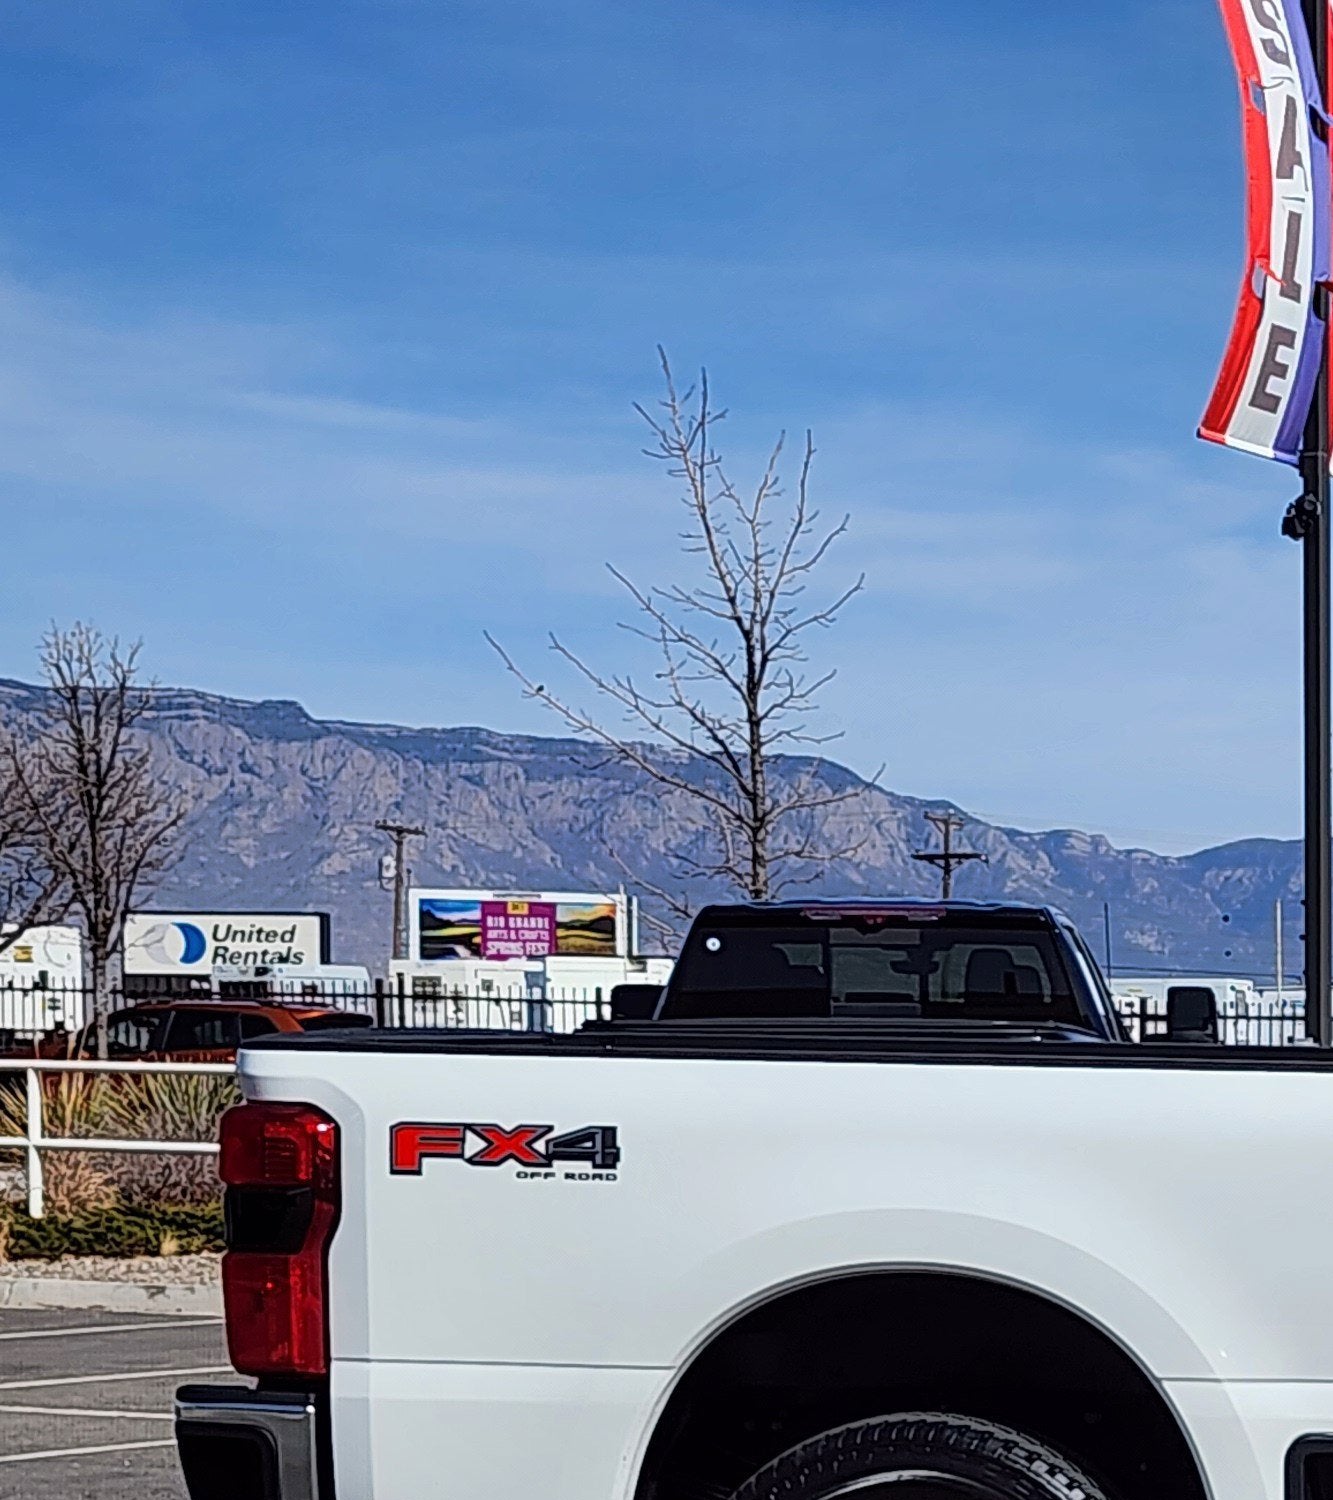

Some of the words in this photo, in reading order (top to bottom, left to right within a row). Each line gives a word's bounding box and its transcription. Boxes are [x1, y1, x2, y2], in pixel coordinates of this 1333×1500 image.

[1248, 0, 1307, 415] SALE
[212, 923, 297, 943] United
[211, 945, 305, 965] Rentals
[390, 1121, 620, 1176] FX4
[516, 1171, 556, 1180] OFF
[564, 1172, 618, 1181] ROAD
